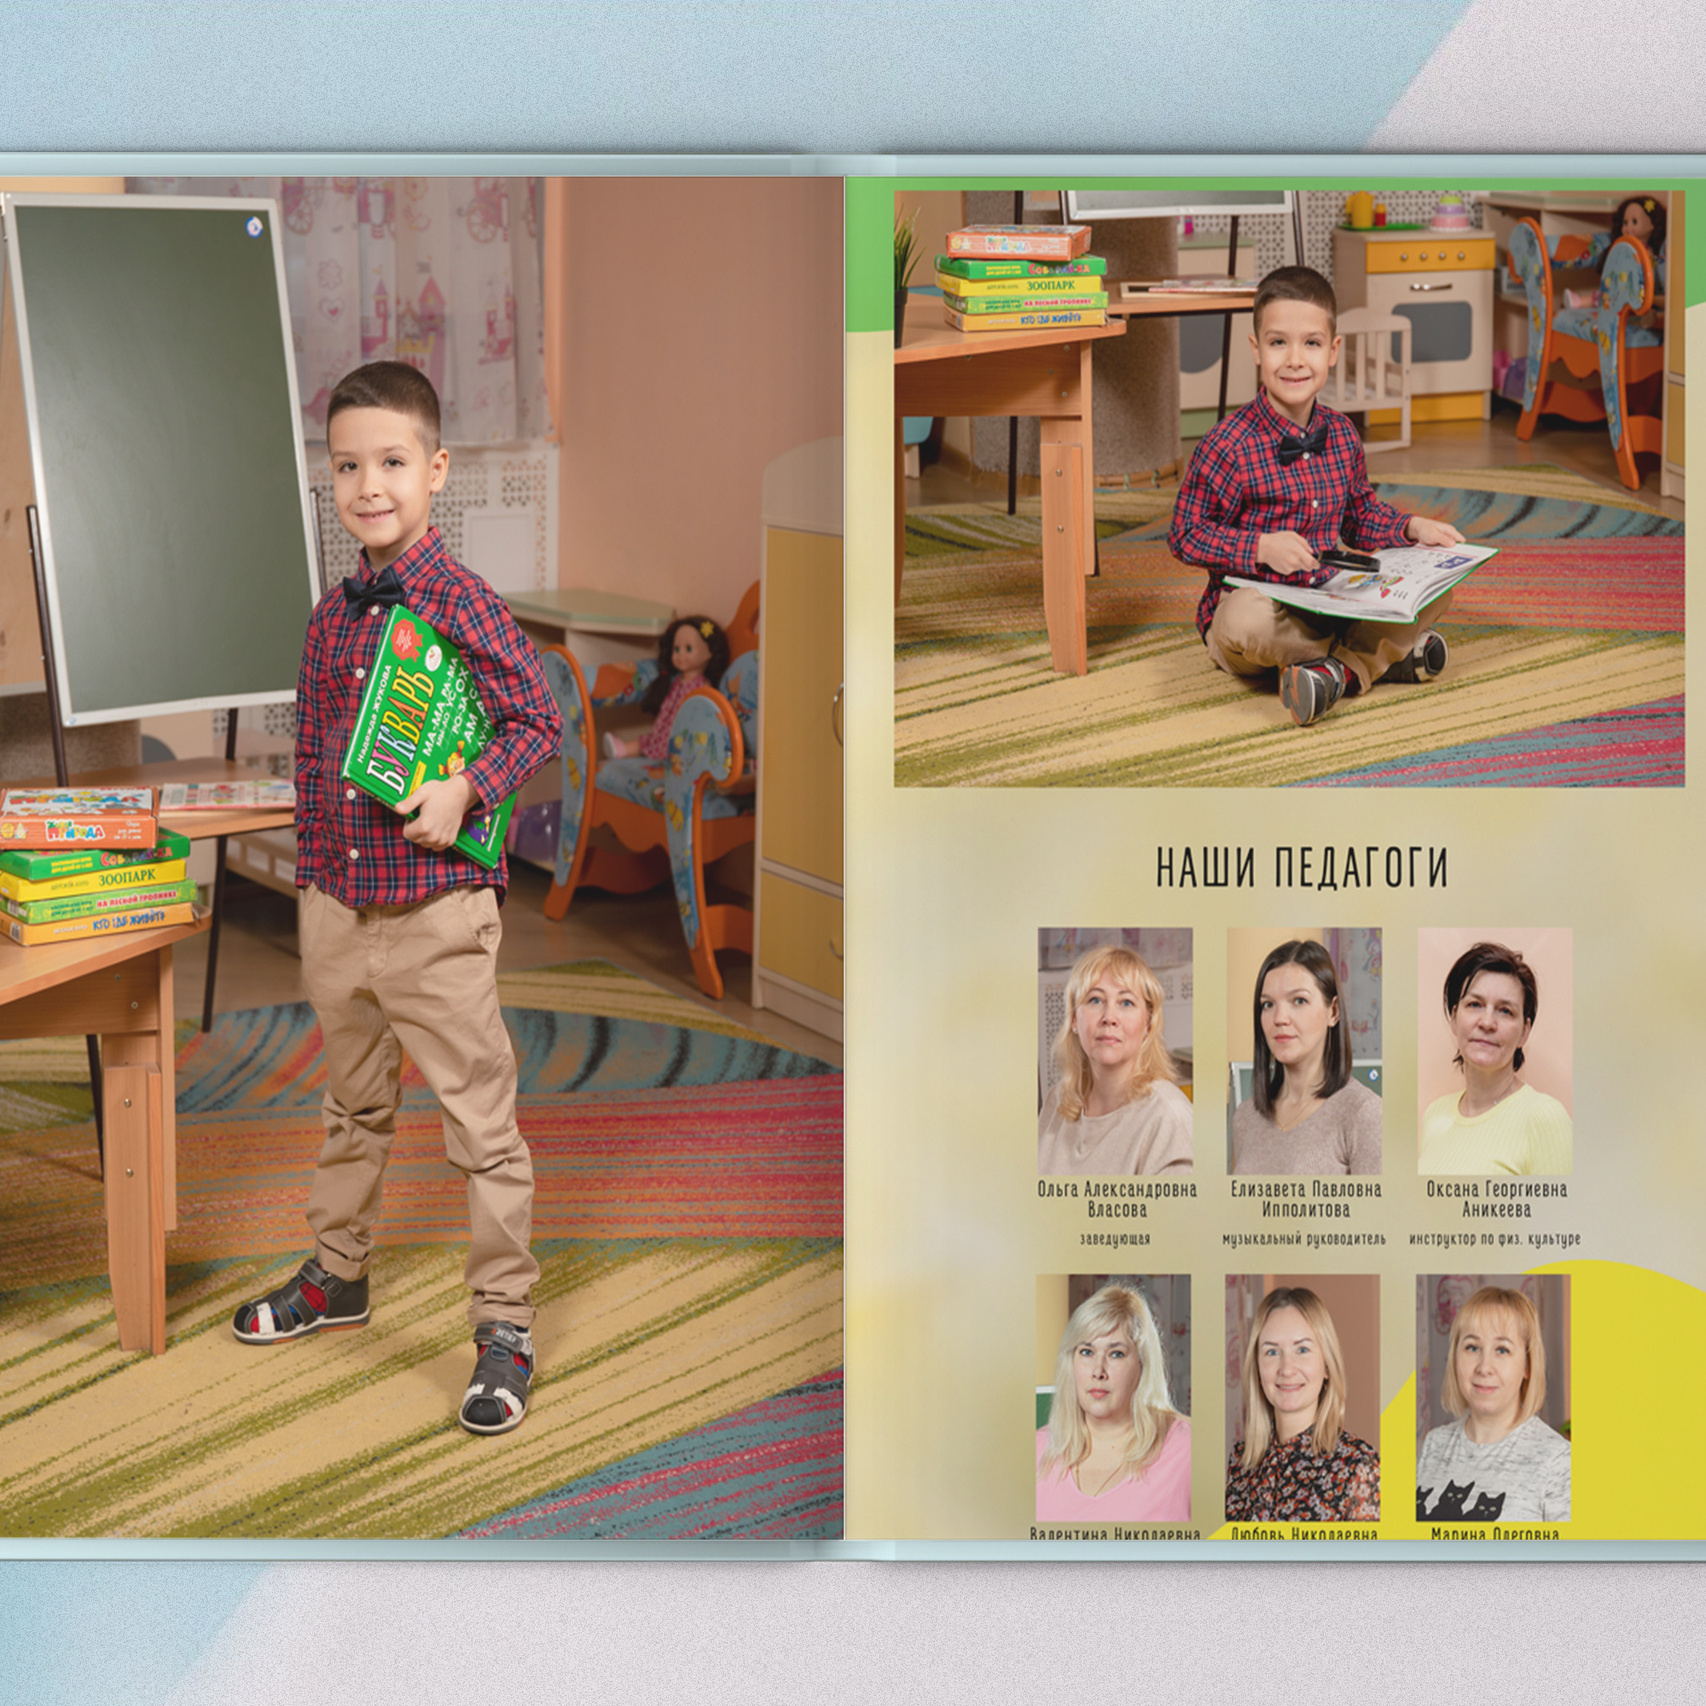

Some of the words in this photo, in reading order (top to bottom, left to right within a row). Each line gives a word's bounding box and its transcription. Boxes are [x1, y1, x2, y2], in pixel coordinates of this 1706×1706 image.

[1026, 280, 1075, 291] ЗООПАРК
[455, 666, 469, 693] ОХ
[357, 713, 378, 764] Надежда
[373, 665, 392, 714] ЖУКОВА
[422, 702, 445, 757] МА-МА
[441, 658, 458, 697] РА-МА
[451, 696, 469, 735] РО-ЗА
[366, 665, 435, 795] БУКВАРЬ
[464, 713, 478, 744] АМ
[98, 868, 156, 886] ЗООПАРК
[1157, 846, 1255, 888] НАШИ
[1276, 846, 1448, 891] ПЕДАГОГИ
[92, 917, 110, 931] КТО
[1038, 1180, 1079, 1198] Ольга
[1084, 1180, 1198, 1200] Александровна
[1231, 1180, 1306, 1198] Елизавета
[1312, 1180, 1382, 1198] Павловна
[1427, 1180, 1480, 1198] Оксана
[1486, 1180, 1568, 1200] Георгиевна
[1088, 1200, 1147, 1218] Власова
[1262, 1200, 1351, 1218] Ипполитова
[1462, 1200, 1532, 1218] Аникеева
[1080, 1233, 1151, 1249] заведующая
[1222, 1231, 1302, 1249] музыкальный
[1307, 1233, 1387, 1249] руководитель
[1409, 1233, 1477, 1249] инструктор
[1481, 1233, 1495, 1246] по
[1498, 1233, 1523, 1247] физ.
[1528, 1233, 1581, 1249] культуре
